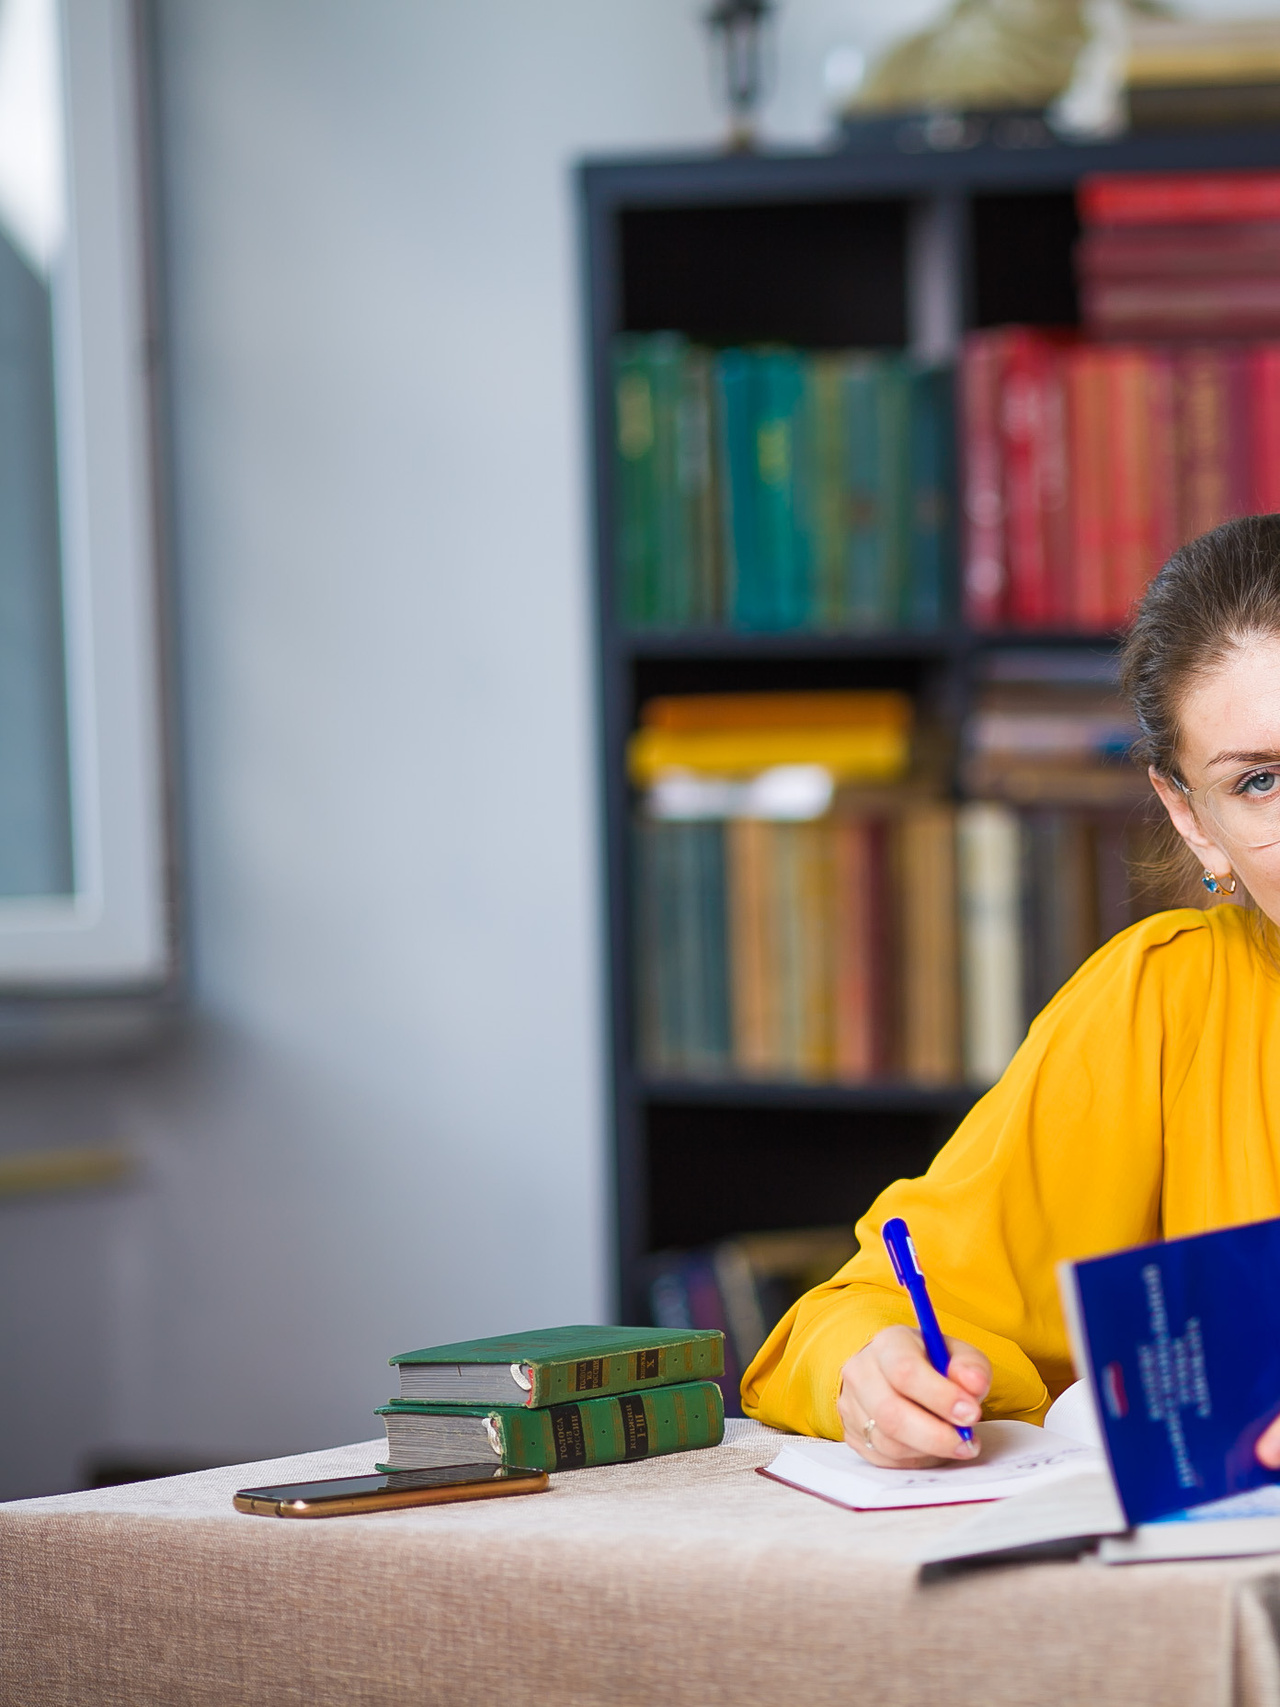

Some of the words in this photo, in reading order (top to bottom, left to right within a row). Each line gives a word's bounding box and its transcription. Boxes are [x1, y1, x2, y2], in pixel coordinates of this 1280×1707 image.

[556, 1417, 568, 1459] ГОЛОСА
[566, 1430, 574, 1444] ИЗ
[571, 1414, 582, 1457] РОССИИ
[625, 1404, 637, 1449] КНИЖКИ
